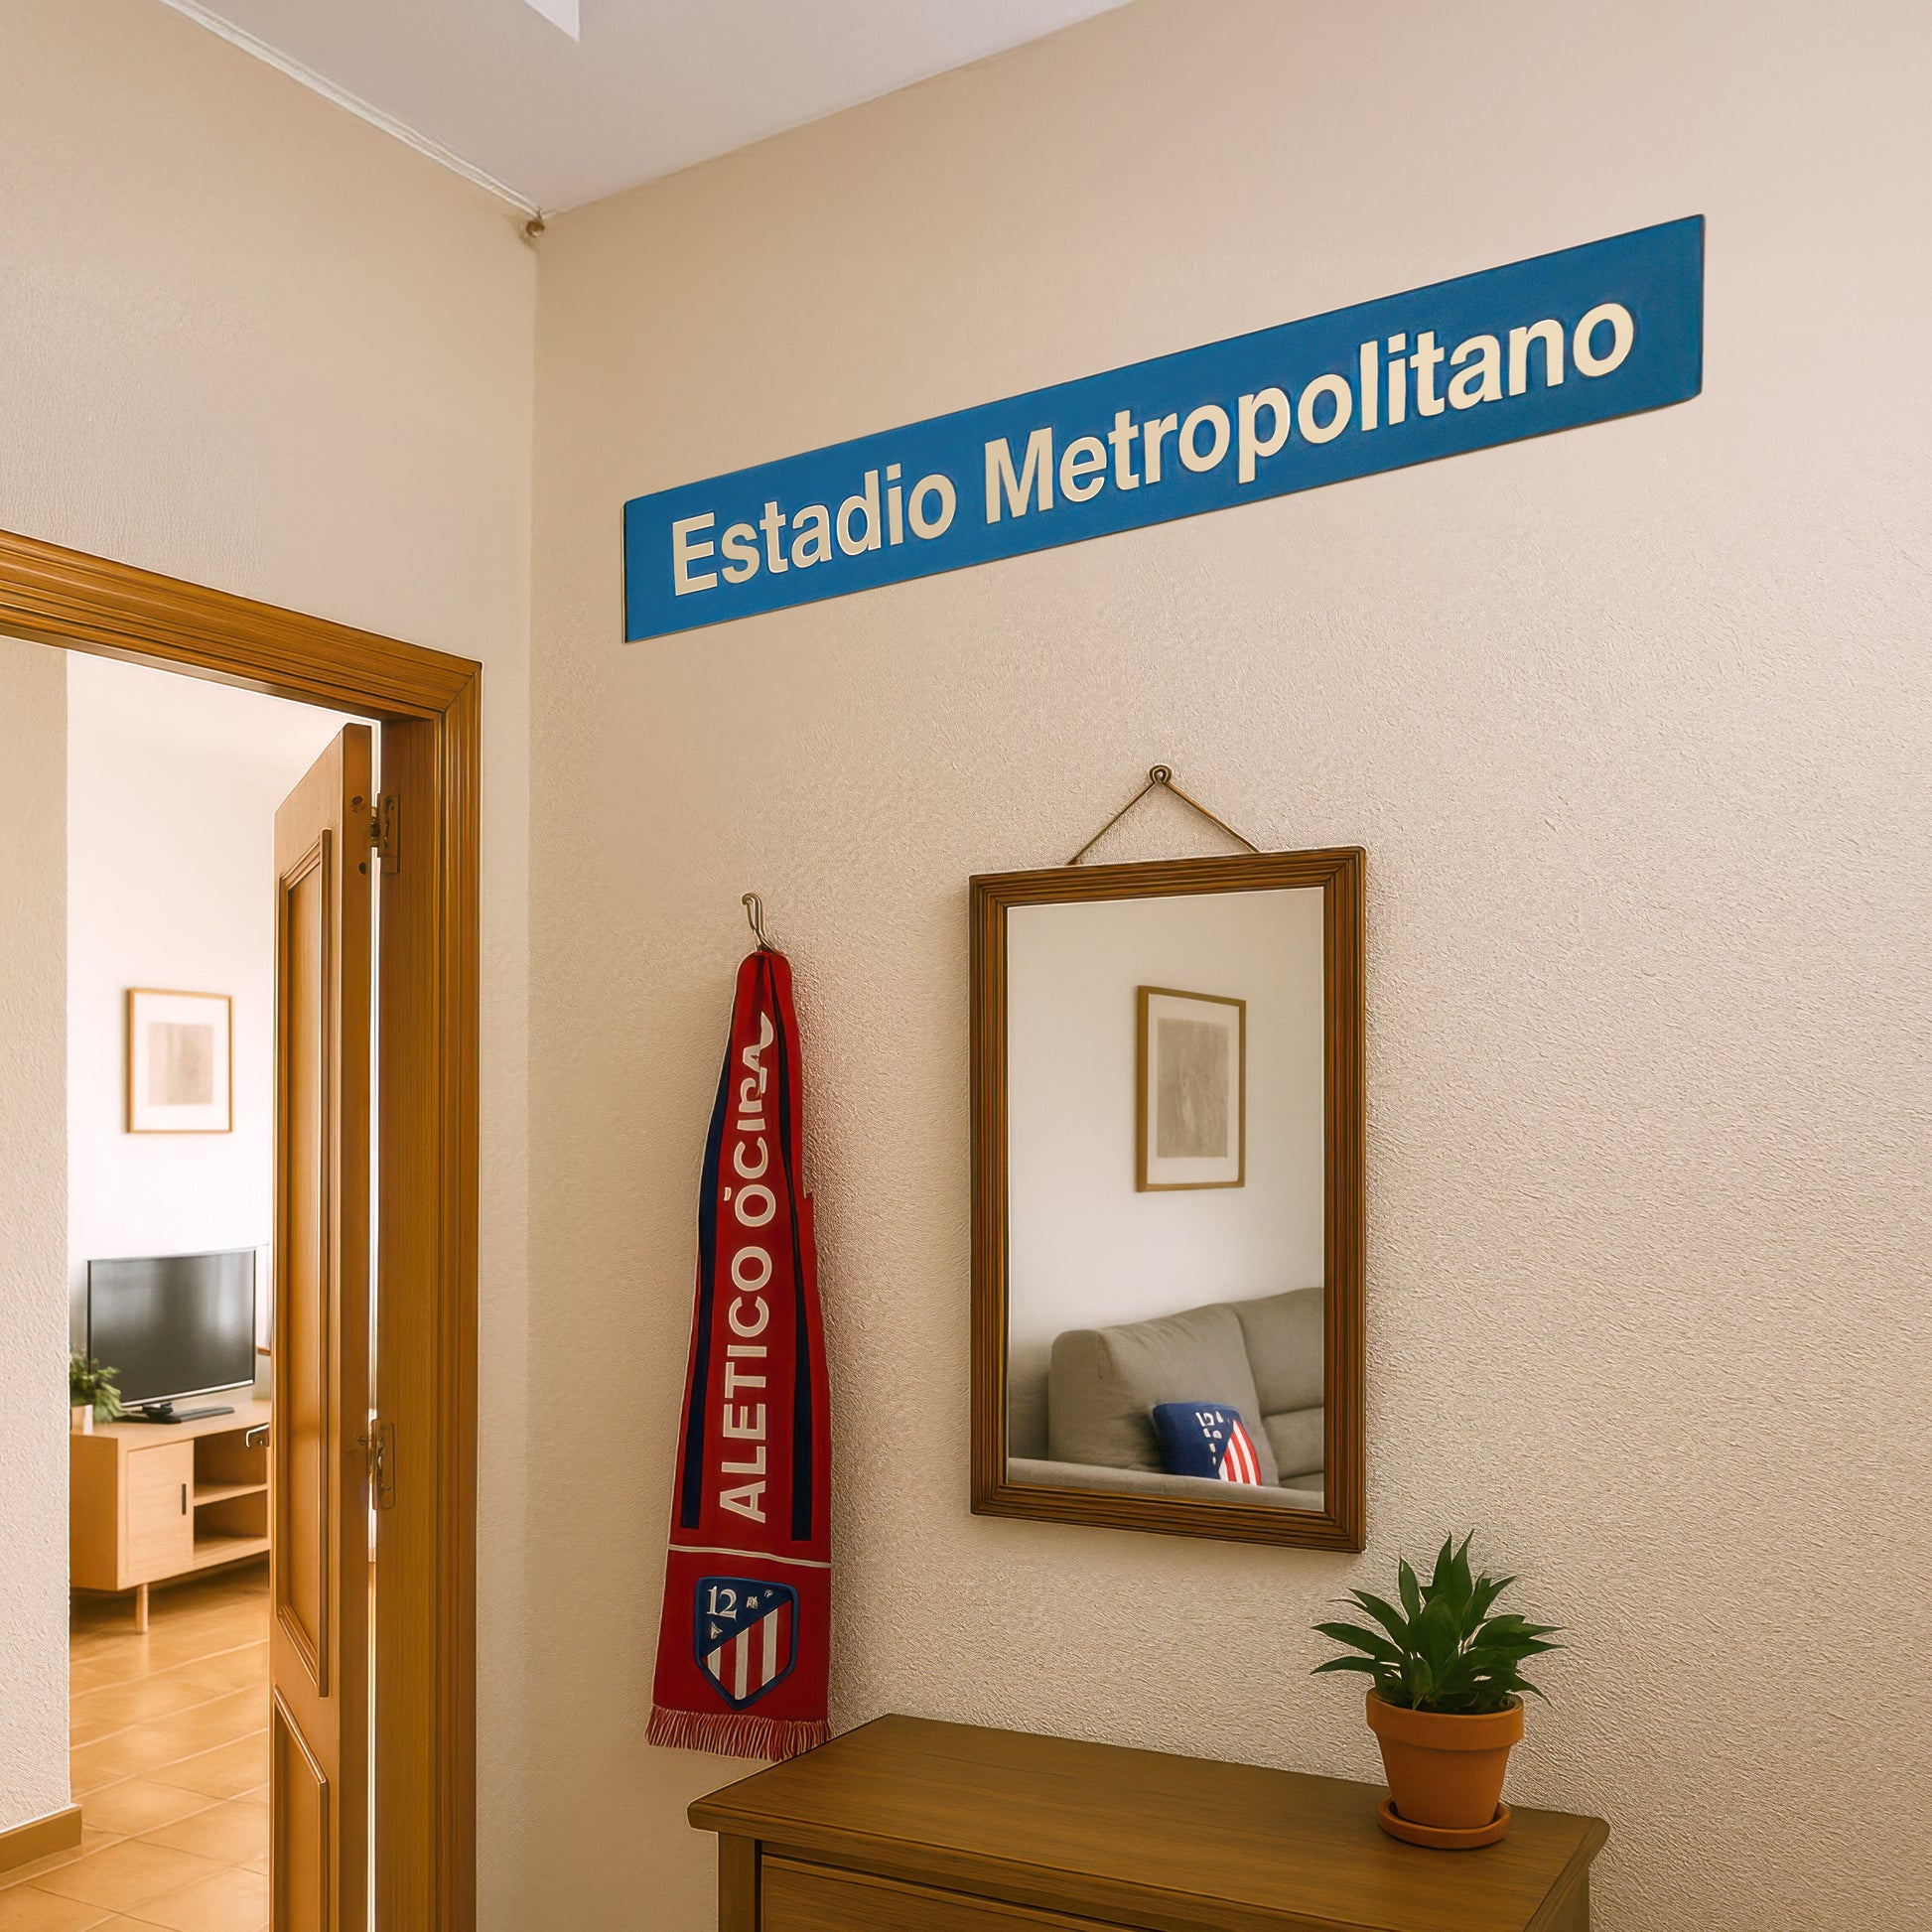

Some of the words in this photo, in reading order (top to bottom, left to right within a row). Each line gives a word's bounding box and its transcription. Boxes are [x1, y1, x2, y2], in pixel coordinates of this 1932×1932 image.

[672, 463, 956, 597] Estadio
[984, 303, 1634, 524] Metropolitano
[719, 1245, 772, 1524] ALETICO
[706, 1586, 738, 1621] 12
